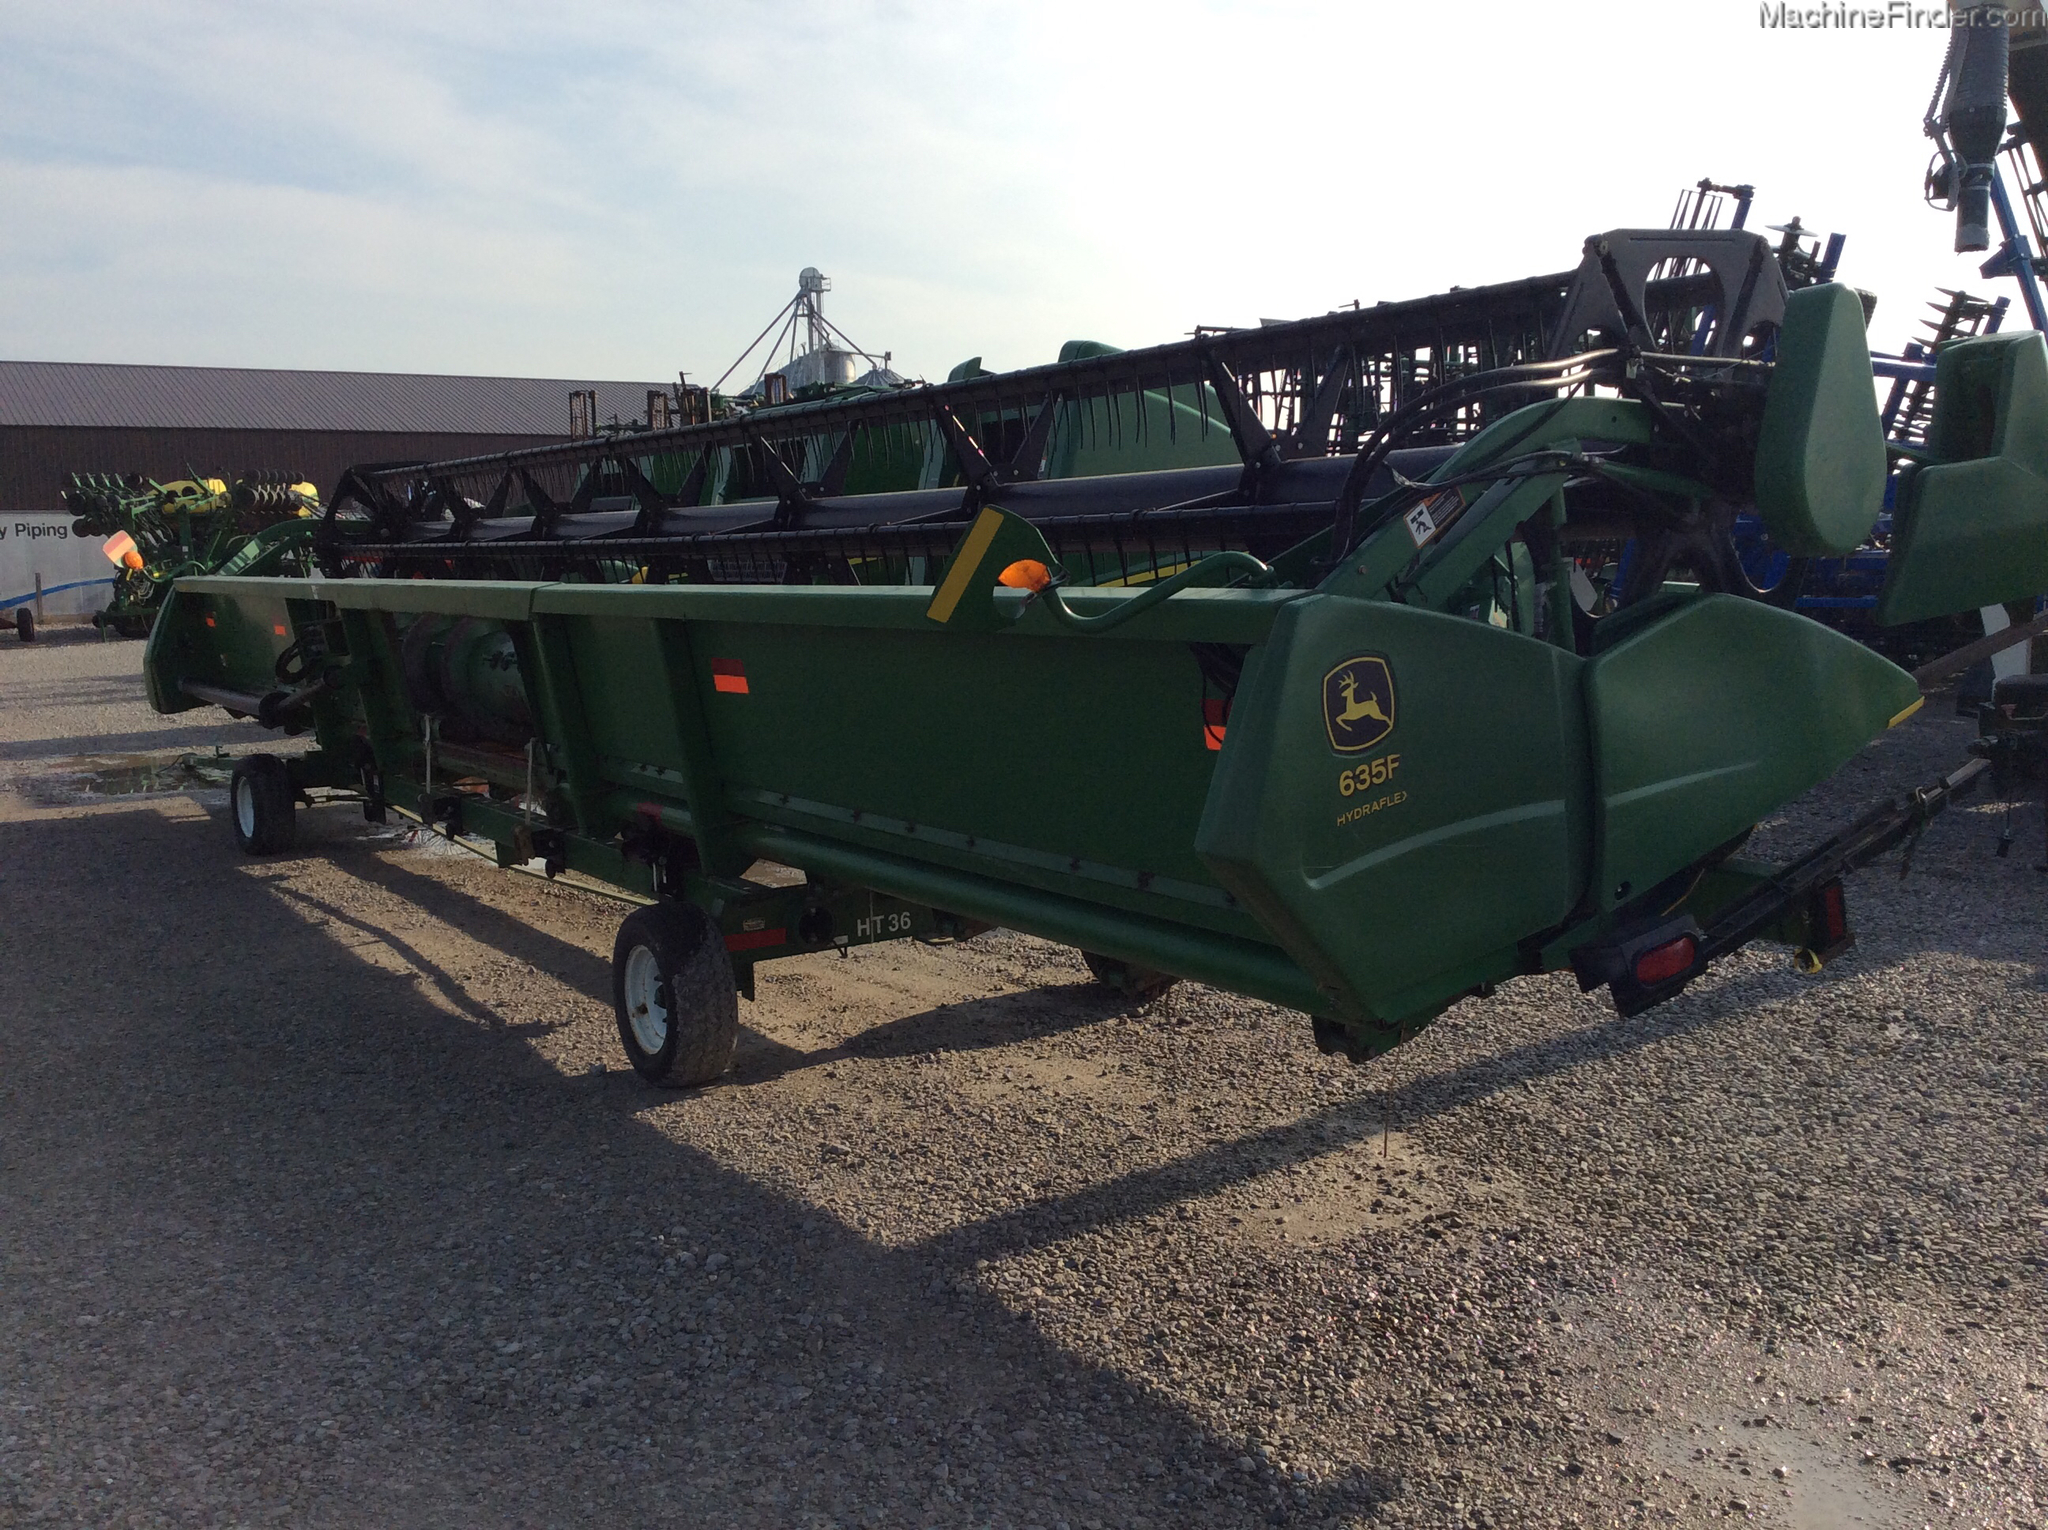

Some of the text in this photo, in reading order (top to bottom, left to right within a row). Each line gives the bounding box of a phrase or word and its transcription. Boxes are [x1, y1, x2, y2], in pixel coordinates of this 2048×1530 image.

[15, 522, 68, 540] Piping
[1338, 753, 1400, 797] 635F
[857, 911, 912, 937] HT 36
